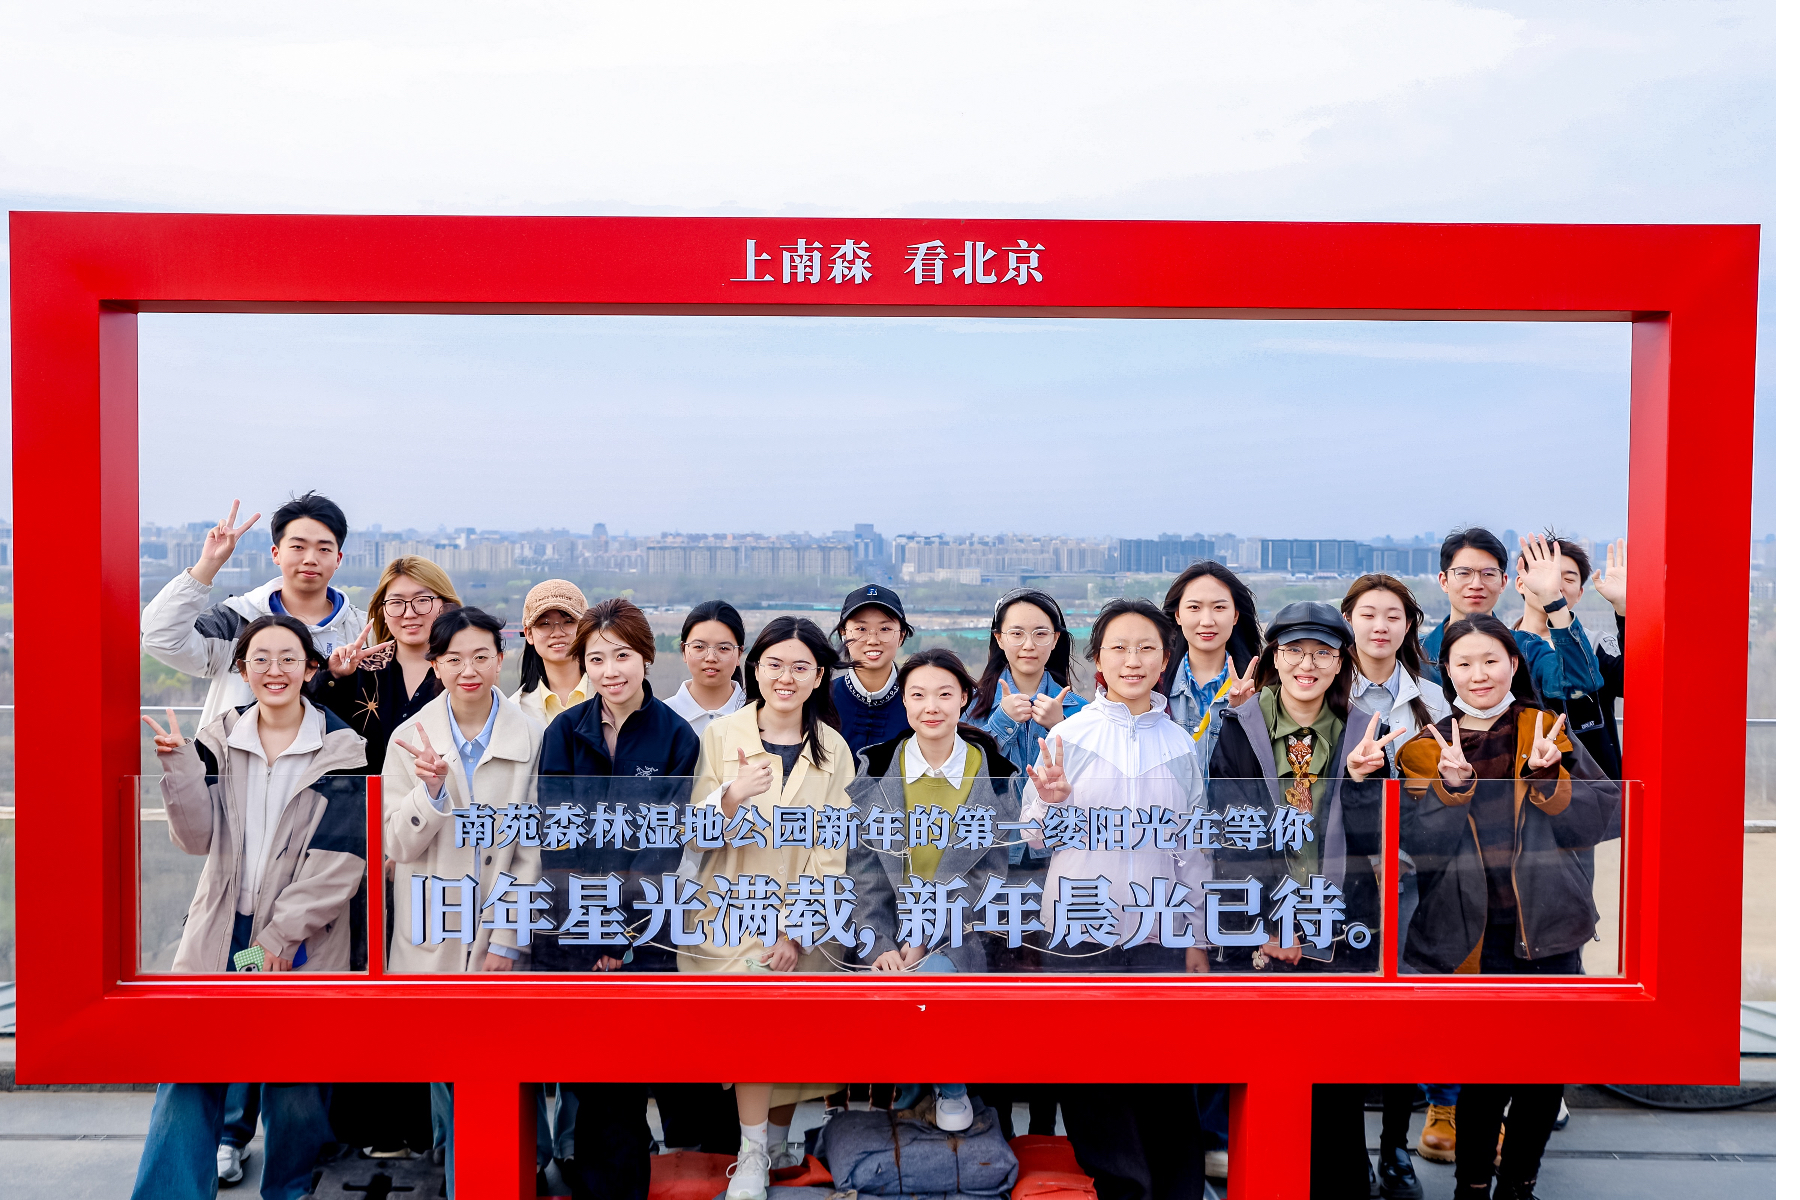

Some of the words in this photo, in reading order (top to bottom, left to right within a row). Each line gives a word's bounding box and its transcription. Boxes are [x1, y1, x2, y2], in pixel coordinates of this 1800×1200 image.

[730, 238, 873, 284] 上南森
[903, 238, 1046, 285] 看北京
[452, 802, 1315, 851] 南苑森林湿地公园新年的第一缕阳光在等你
